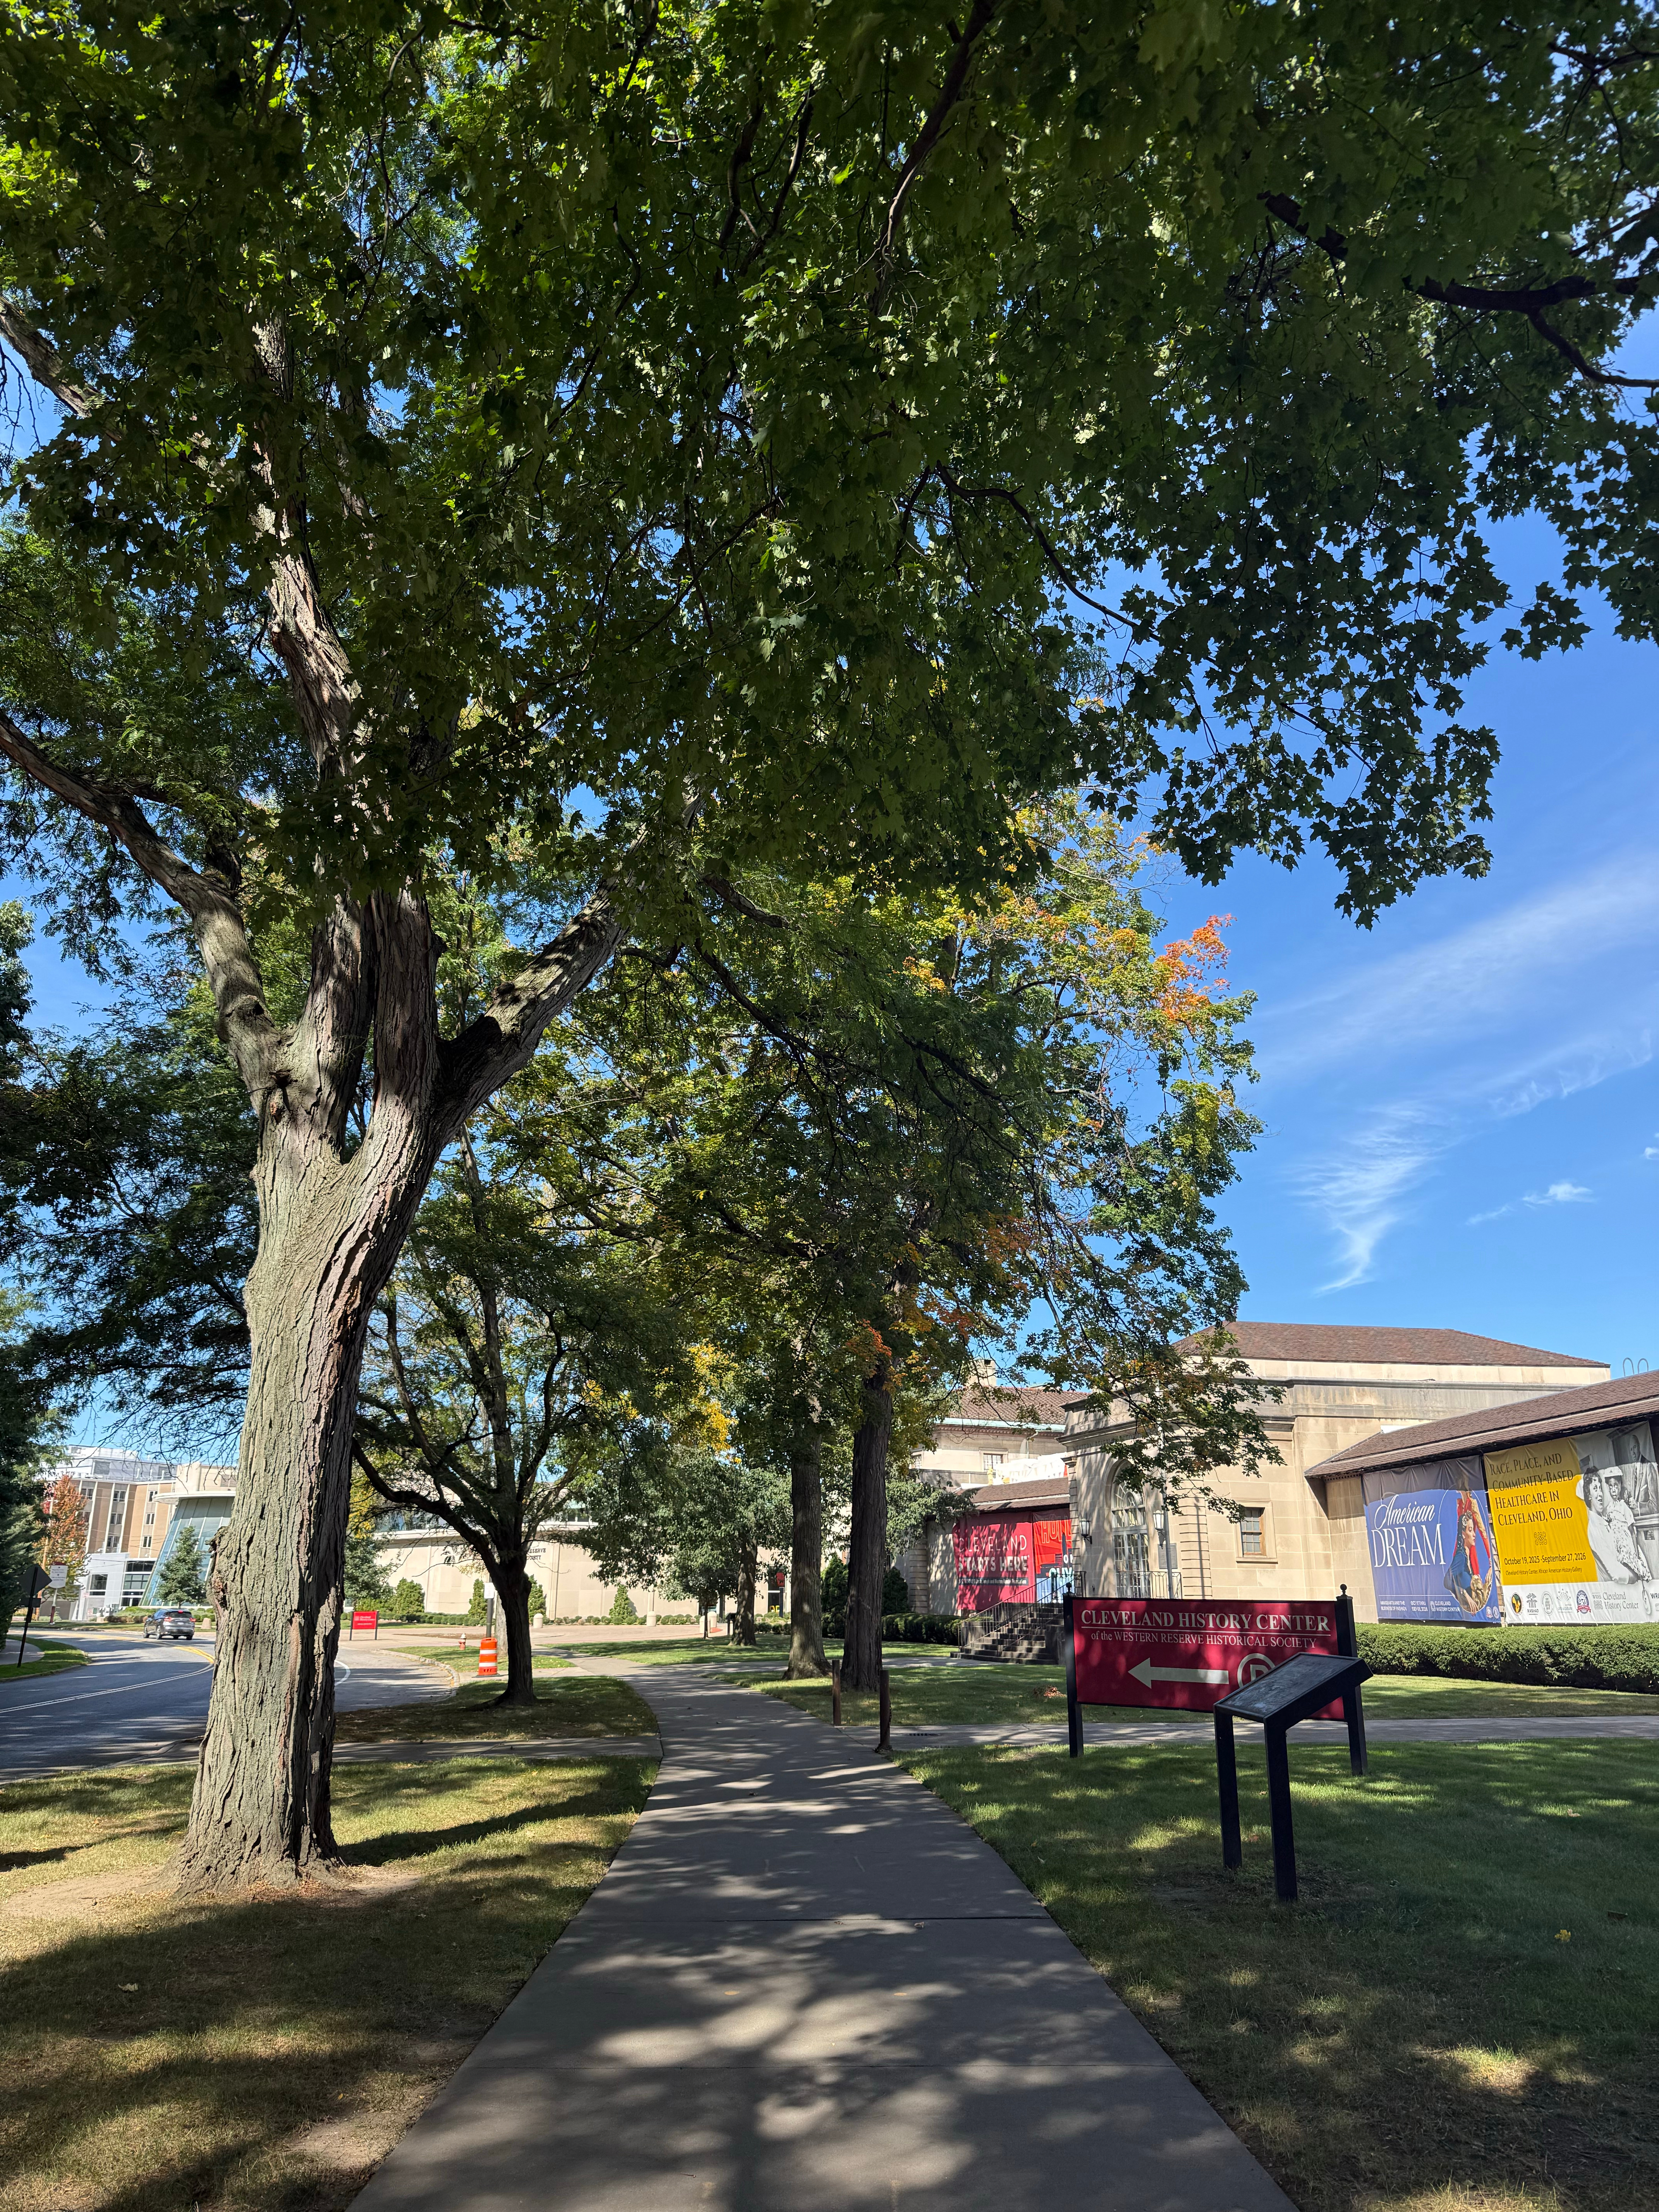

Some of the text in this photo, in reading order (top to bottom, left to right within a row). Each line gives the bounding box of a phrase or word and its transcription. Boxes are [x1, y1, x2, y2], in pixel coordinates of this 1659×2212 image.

[1491, 1453, 1561, 1475] RACE, PLACE, AND
[1493, 1470, 1573, 1492] COMMUNITY-BASED
[1495, 1491, 1559, 1509] HEALTHCARE IN
[1374, 1492, 1435, 1530] American
[1498, 1507, 1573, 1525] CLEVELAND, OHIO
[959, 1535, 1027, 1552] CLEVELAND
[1371, 1523, 1446, 1567] DREAM
[959, 1557, 996, 1571] STARTS
[1602, 1592, 1626, 1600] Cleveland
[1604, 1601, 1638, 1611] History Center
[1081, 1610, 1331, 1631] CLEVELAND HISTORY CENTER
[1091, 1631, 1317, 1648] of the WESTERN RESERVE HISTORICAL SOCIETY
